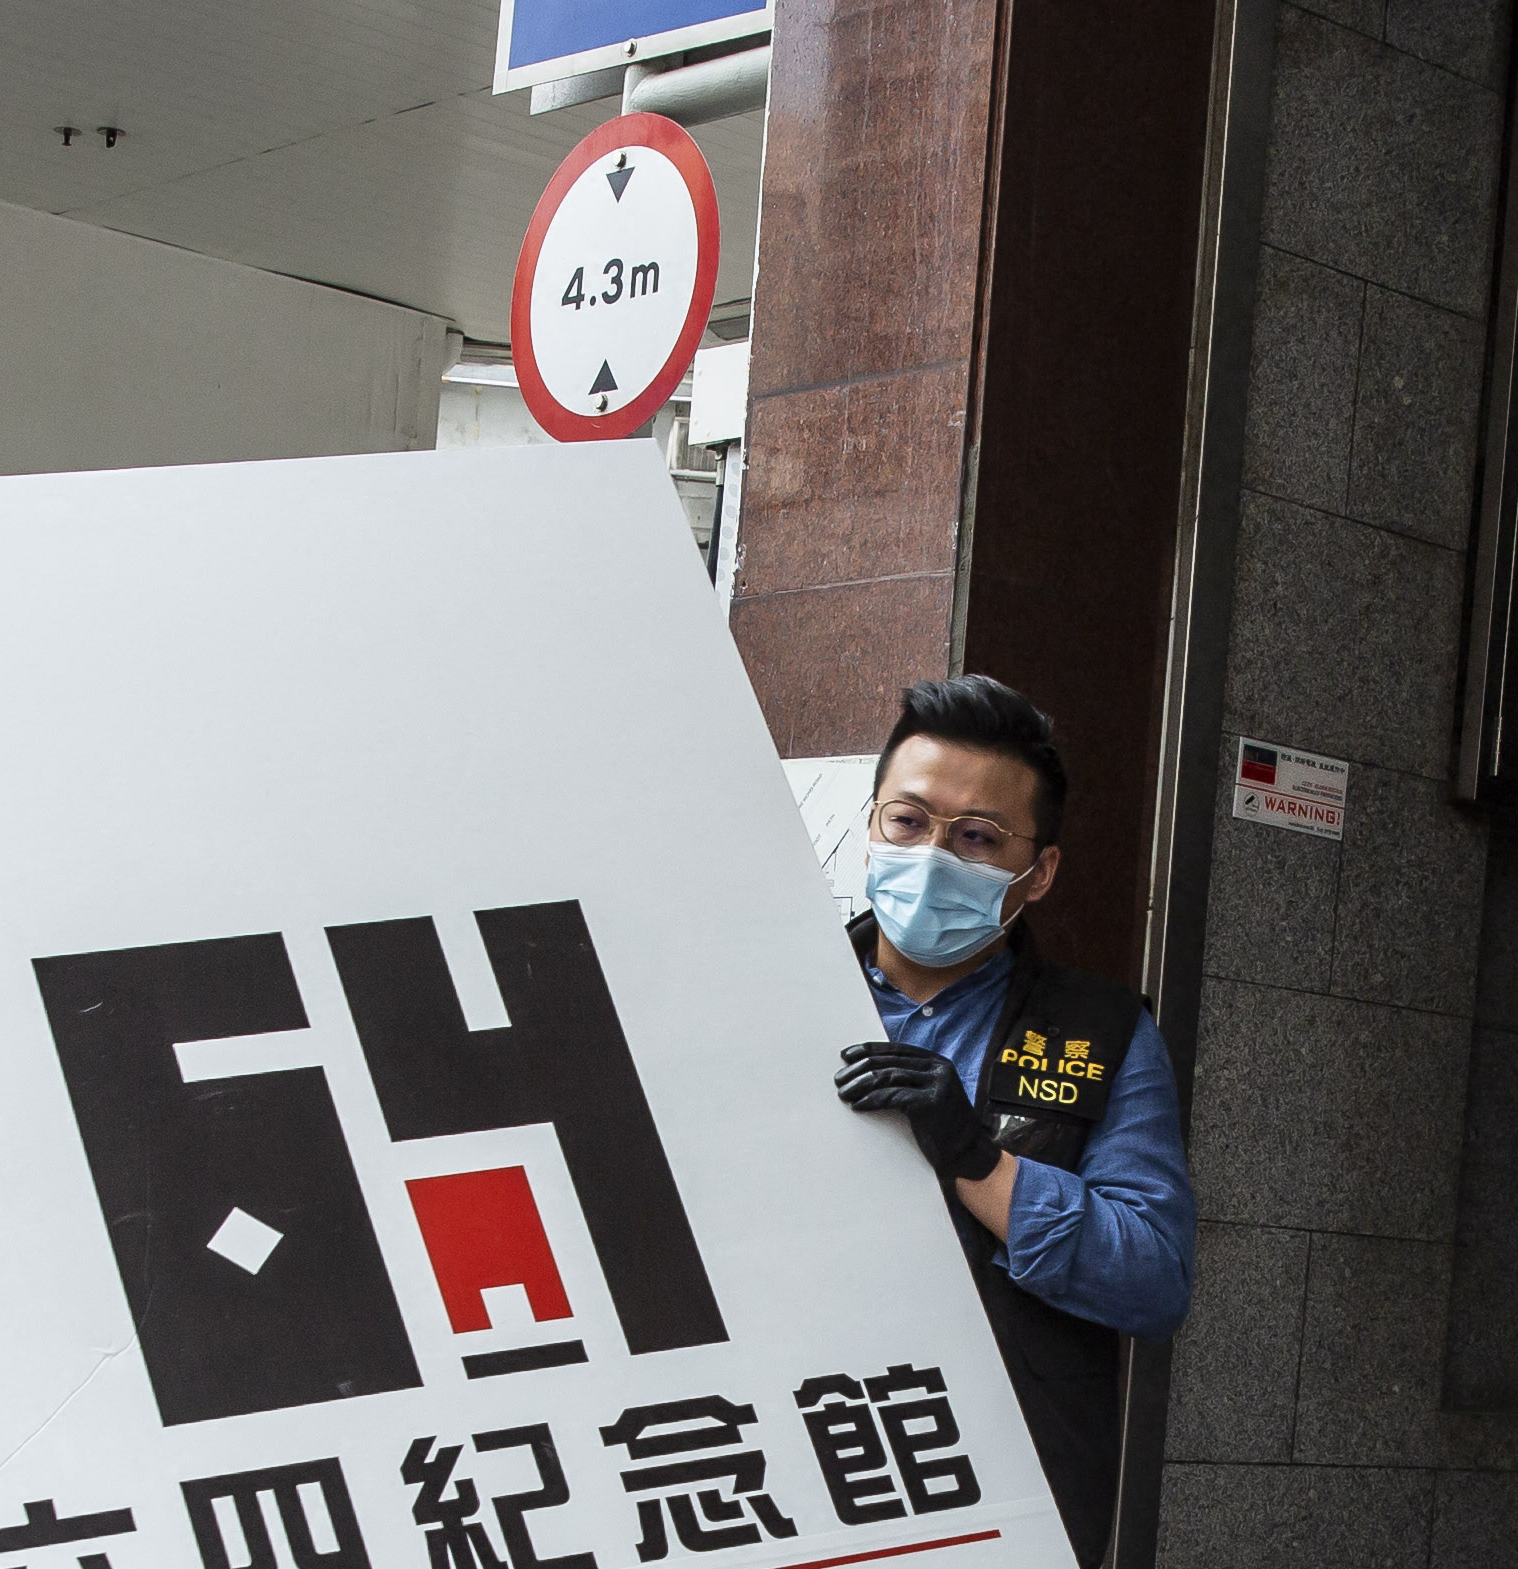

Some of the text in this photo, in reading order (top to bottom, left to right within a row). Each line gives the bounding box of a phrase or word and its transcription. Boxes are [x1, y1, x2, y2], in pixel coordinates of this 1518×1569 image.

[561, 258, 660, 310] 4.3m
[1264, 795, 1341, 826] WARNING!
[1018, 1075, 1078, 1104] NSD
